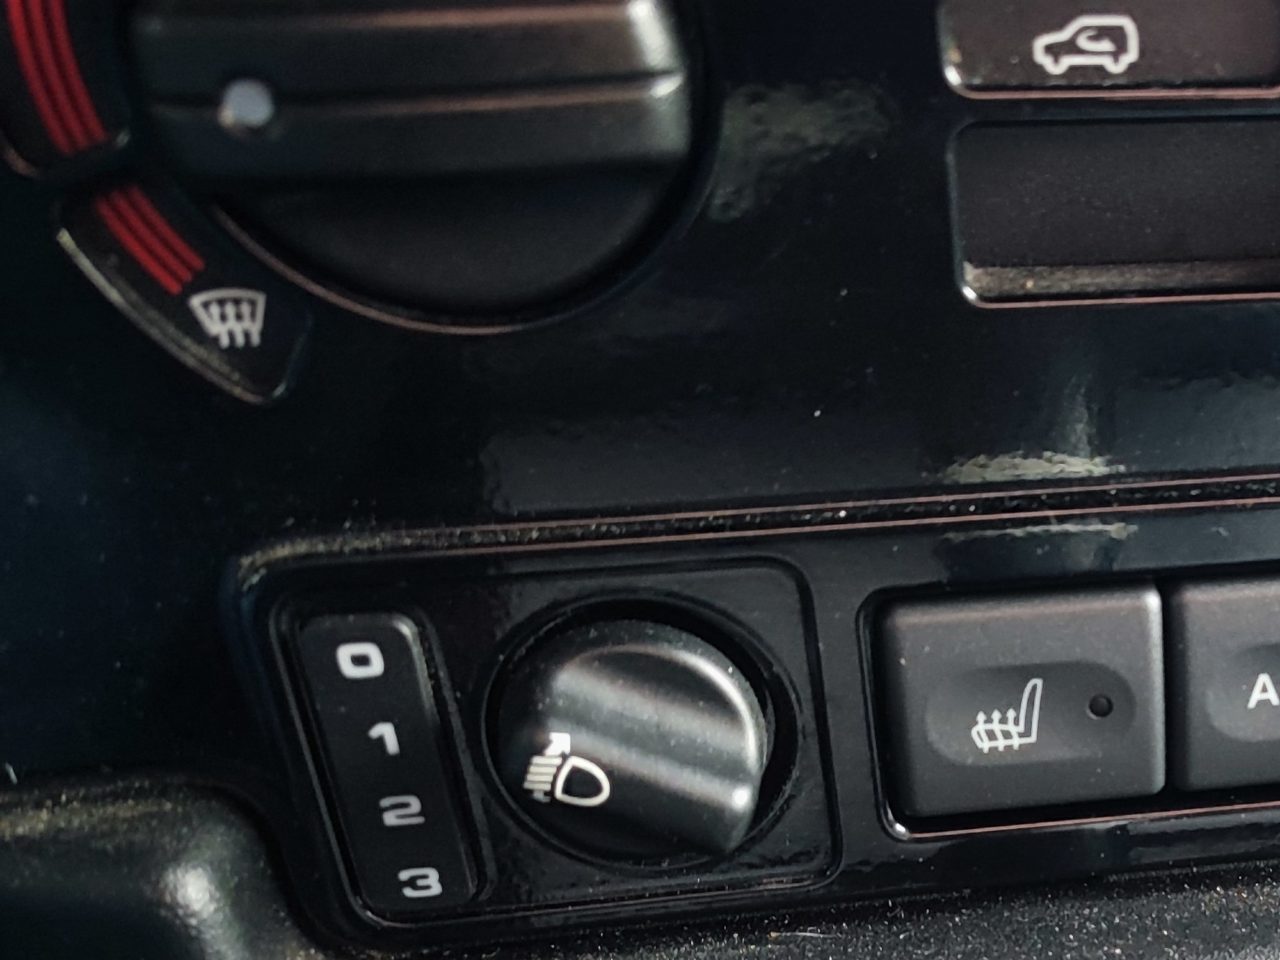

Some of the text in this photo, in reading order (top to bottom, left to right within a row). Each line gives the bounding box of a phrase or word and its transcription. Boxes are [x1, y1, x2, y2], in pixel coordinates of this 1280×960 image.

[335, 642, 385, 679] 0
[368, 721, 400, 755] 1
[379, 795, 425, 827] 2
[398, 867, 443, 898] 3
